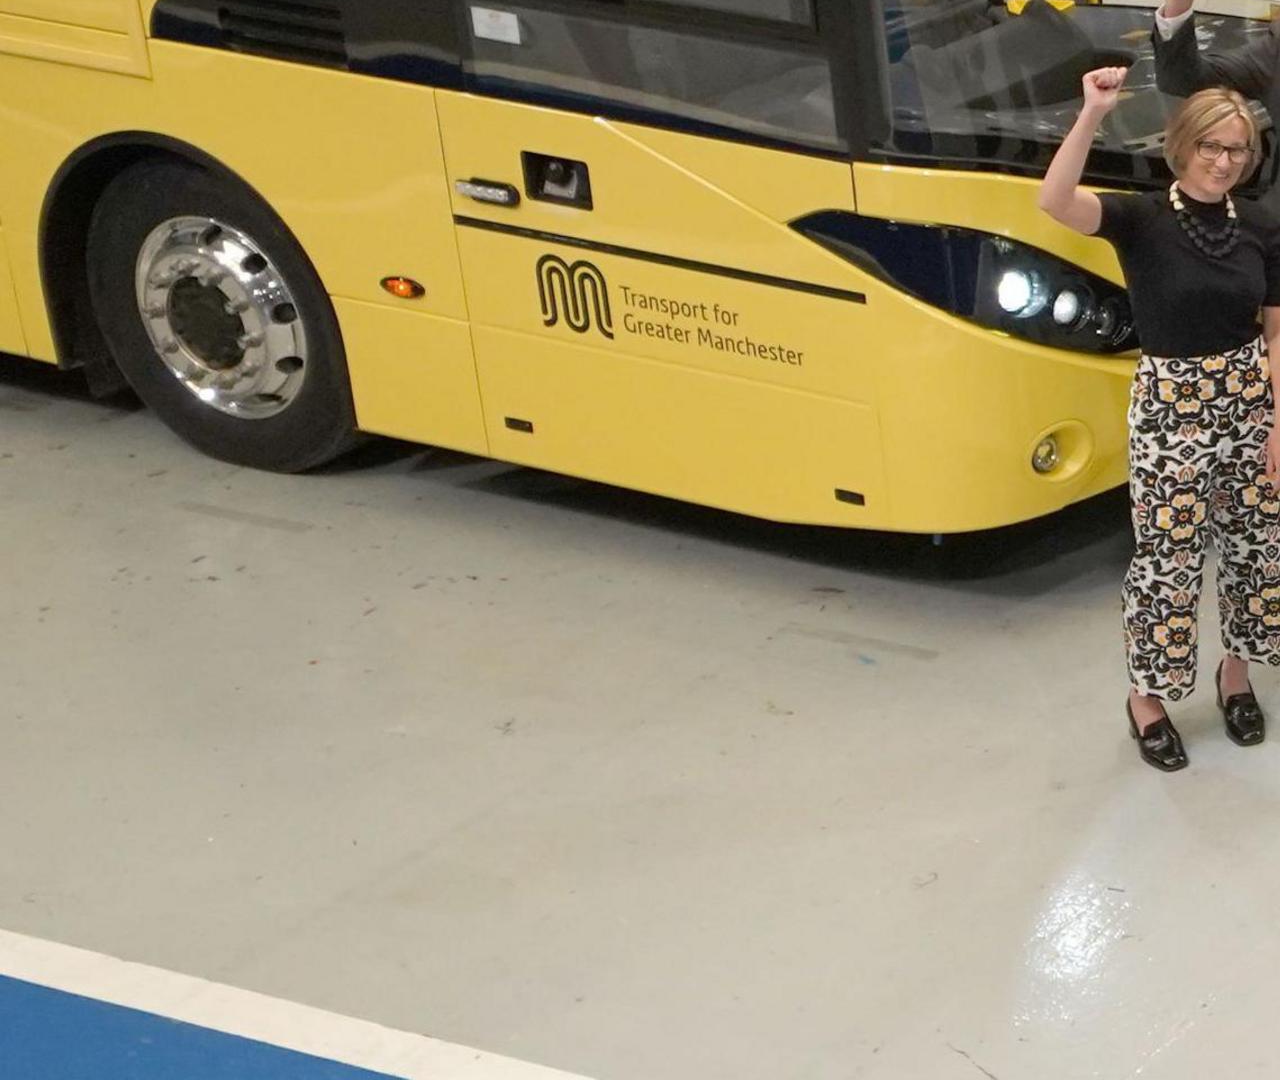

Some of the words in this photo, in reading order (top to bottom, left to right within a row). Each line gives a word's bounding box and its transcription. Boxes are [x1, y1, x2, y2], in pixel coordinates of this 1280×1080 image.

[619, 285, 708, 321] Transport
[713, 304, 739, 327] for
[623, 313, 692, 343] Greater
[697, 329, 804, 366] Manchester
